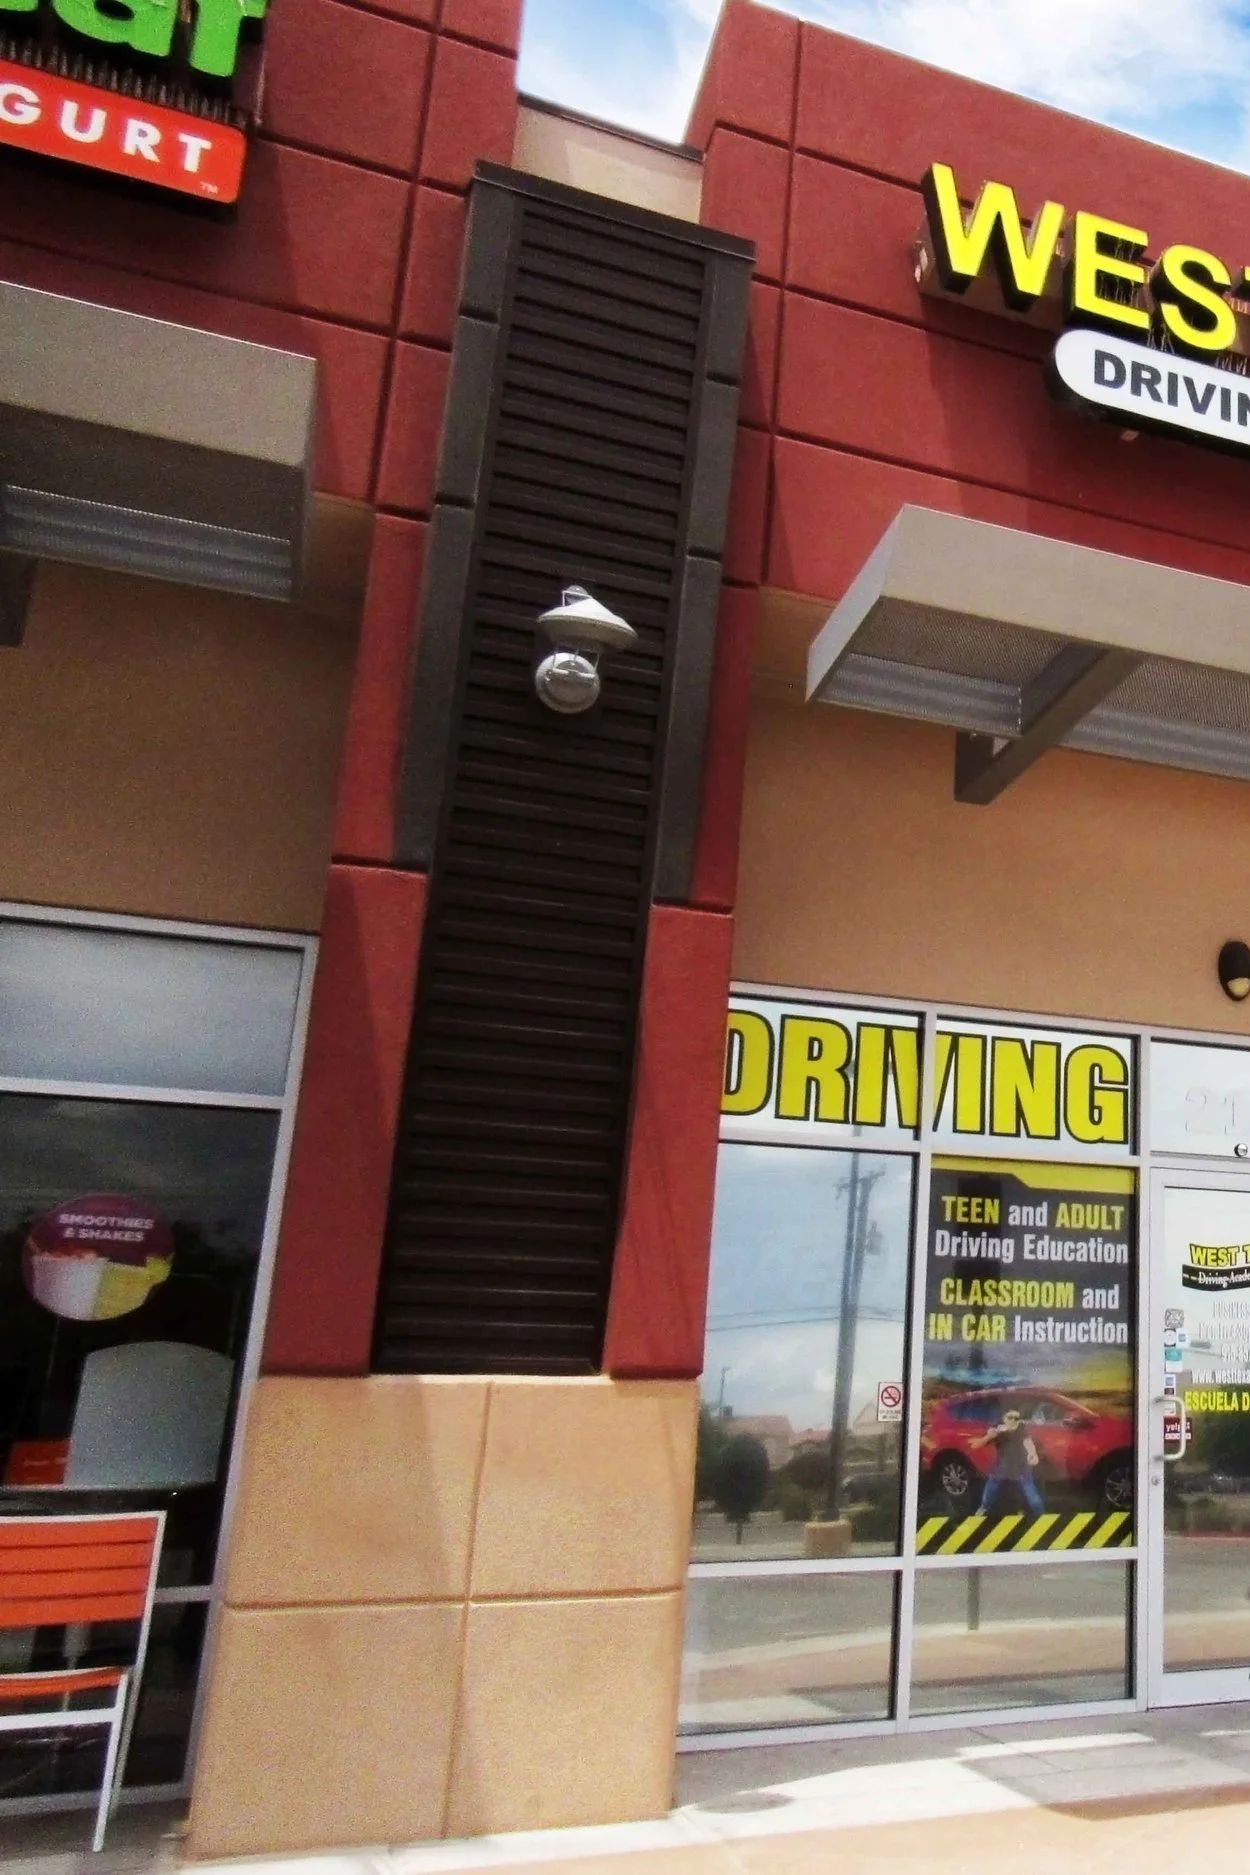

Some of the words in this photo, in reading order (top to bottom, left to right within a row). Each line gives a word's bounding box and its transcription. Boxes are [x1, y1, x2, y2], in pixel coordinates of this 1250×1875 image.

[720, 1009, 1129, 1144] DRIVING
[58, 1214, 154, 1229] SMOOTHIES
[942, 1195, 1000, 1224] TEEN
[1008, 1202, 1048, 1227] and
[1056, 1206, 1125, 1231] ADULT
[78, 1230, 145, 1242] SHAKES
[934, 1231, 1015, 1264] Driving
[1023, 1235, 1129, 1264] Education
[1189, 1243, 1241, 1266] WEST
[940, 1278, 1074, 1309] CLASSROOM
[1082, 1284, 1120, 1309] and
[929, 1314, 953, 1341] IN
[961, 1314, 1006, 1342] CAR
[1014, 1317, 1128, 1343] Instruction
[1184, 1391, 1239, 1412] ESCUELA
